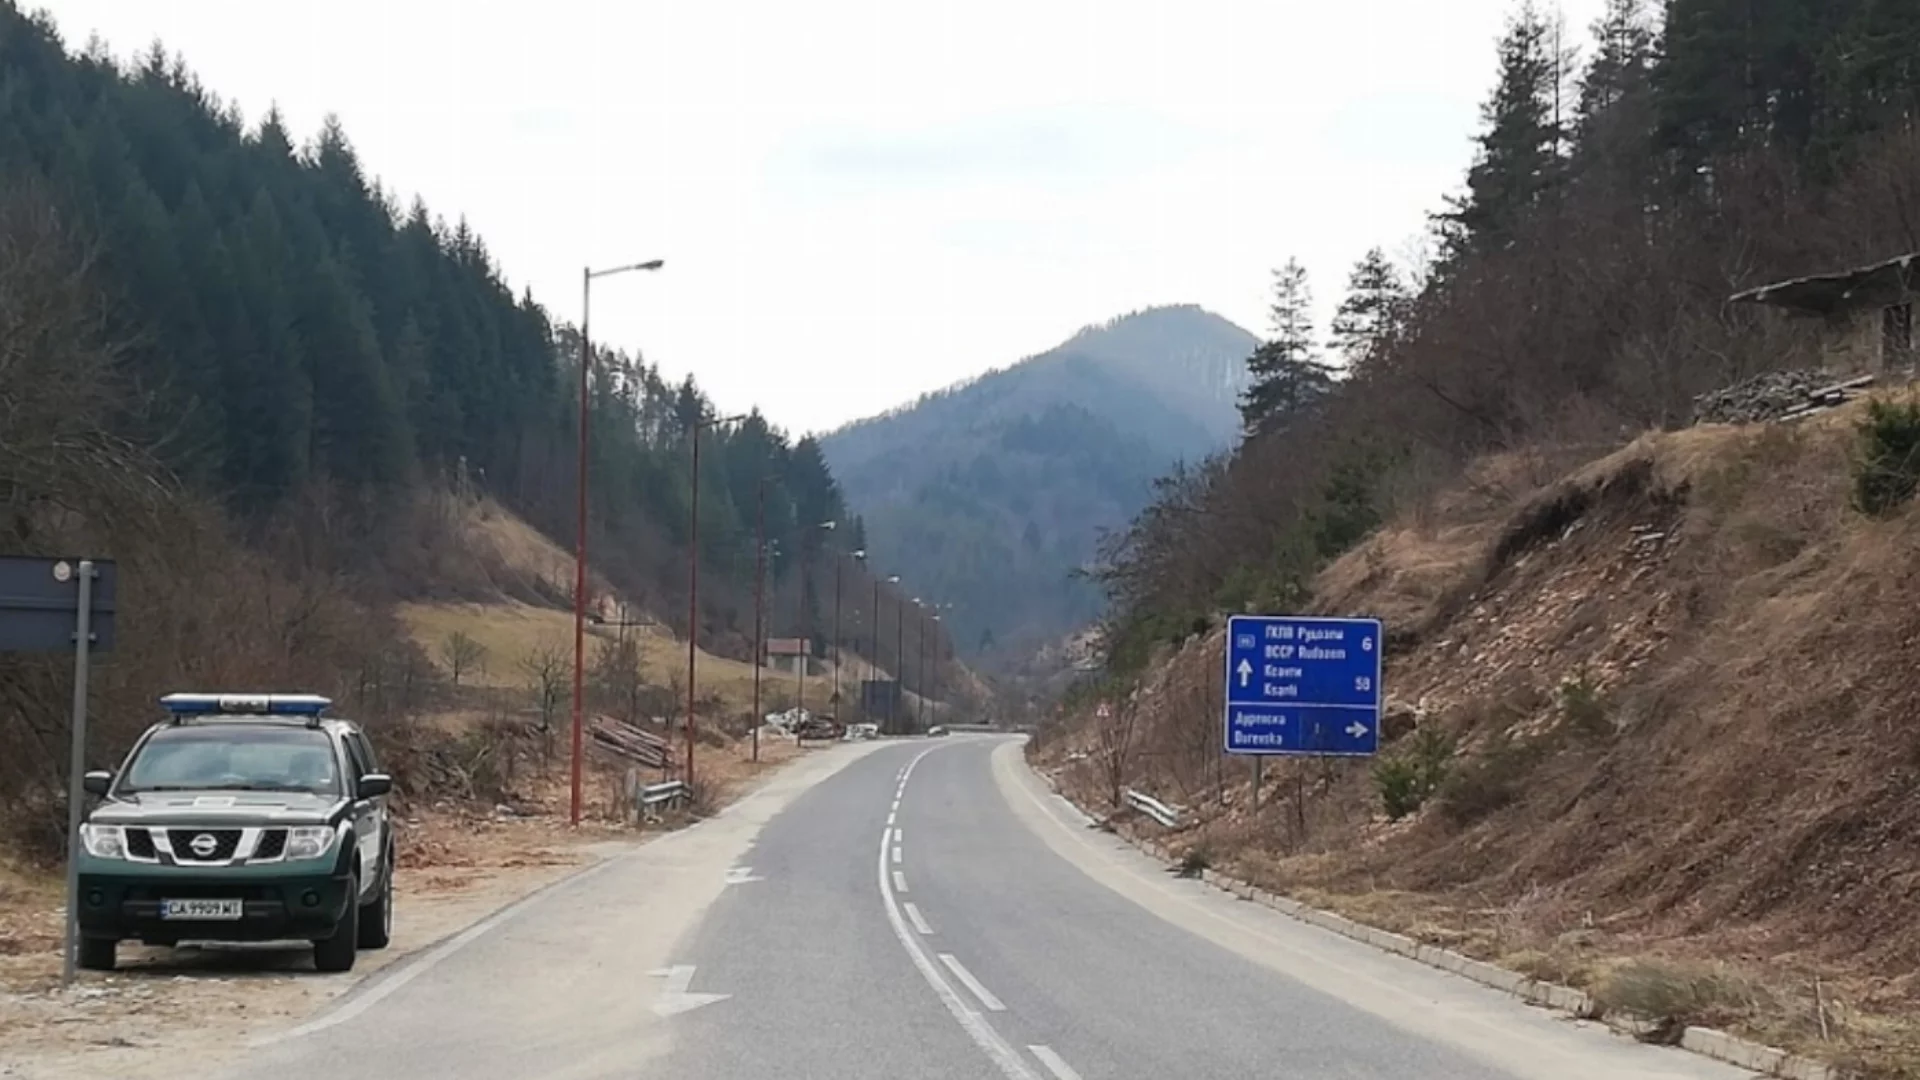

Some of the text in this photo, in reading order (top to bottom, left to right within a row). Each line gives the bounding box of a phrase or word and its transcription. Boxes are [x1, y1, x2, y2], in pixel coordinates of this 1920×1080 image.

[1362, 636, 1372, 651] 6
[1298, 645, 1346, 659] Rudozem
[1263, 664, 1302, 677] Ксанти
[1263, 683, 1297, 697] Ksanti
